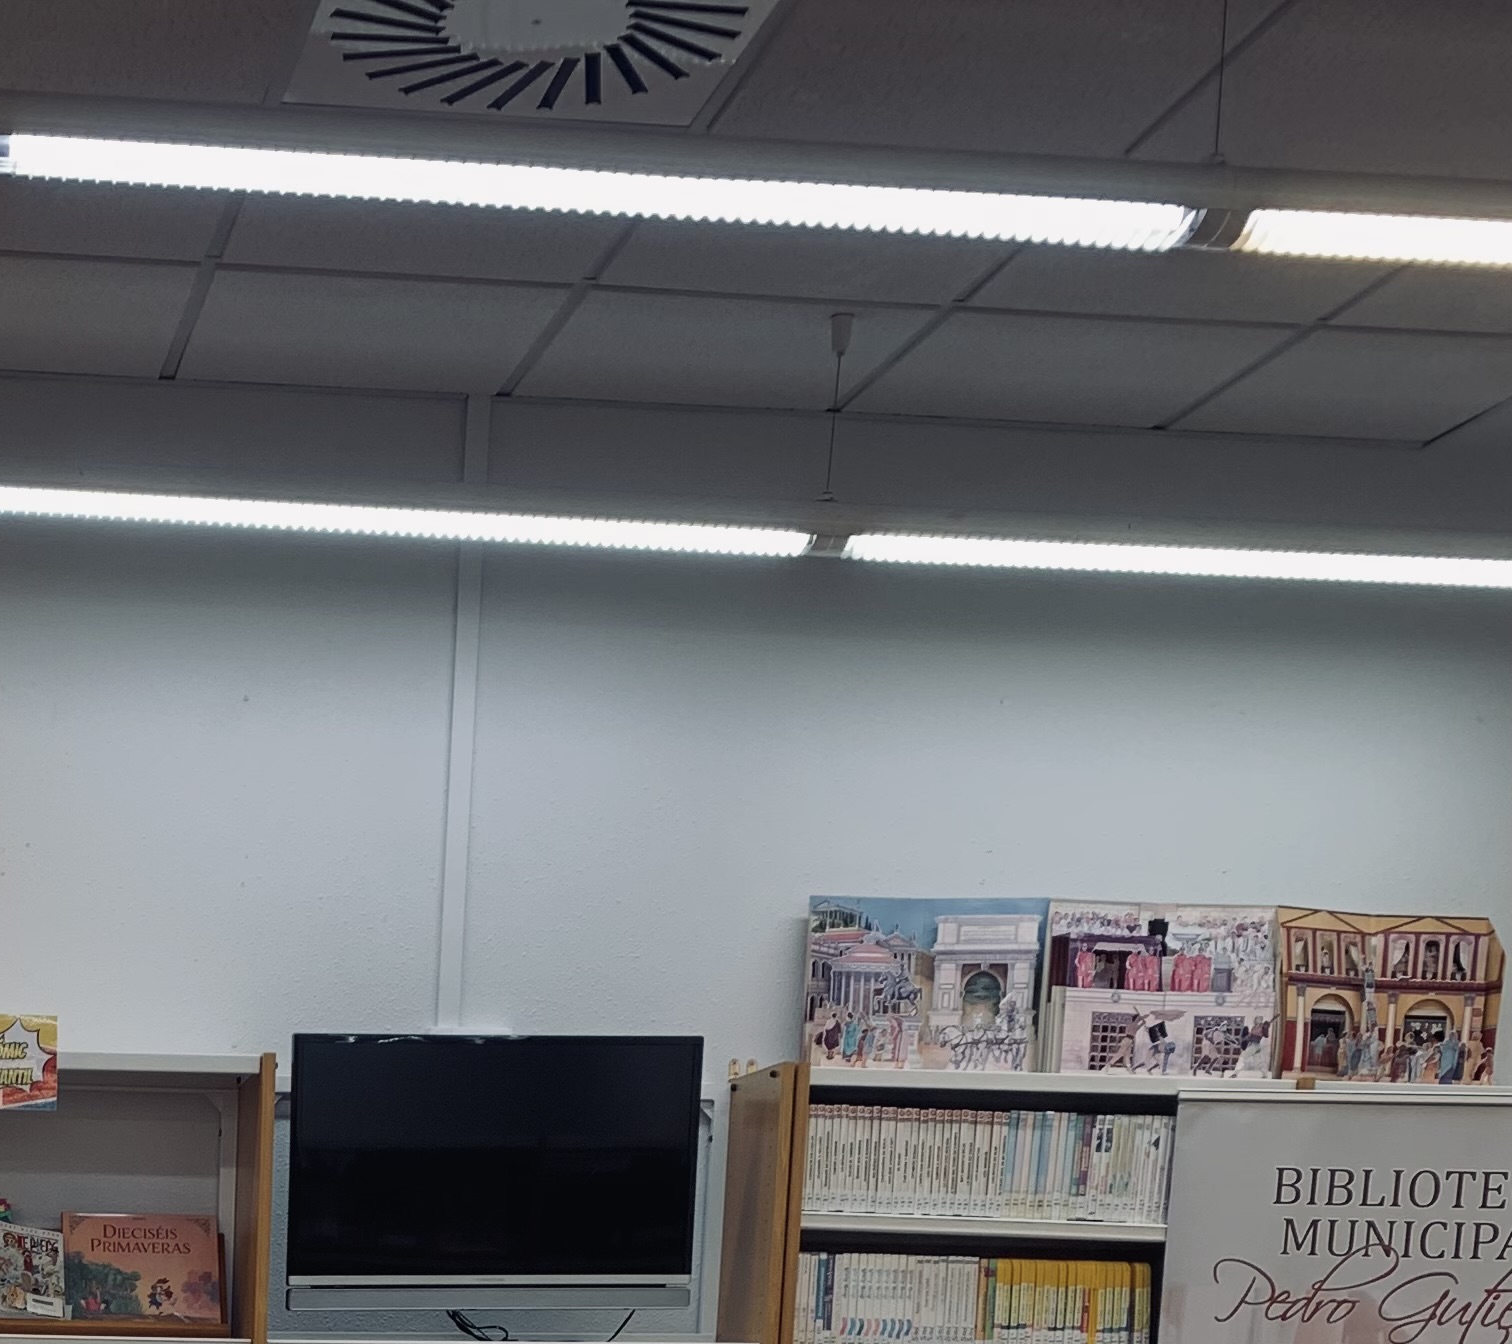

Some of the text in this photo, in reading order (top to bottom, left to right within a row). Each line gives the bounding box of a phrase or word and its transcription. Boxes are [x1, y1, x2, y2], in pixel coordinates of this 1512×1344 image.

[1272, 1167, 1509, 1209] BIBLIOTE
[103, 1223, 178, 1240] DIECISÉIS
[90, 1238, 191, 1255] PRIMAVERAS
[1213, 1243, 1400, 1324] Pedro
